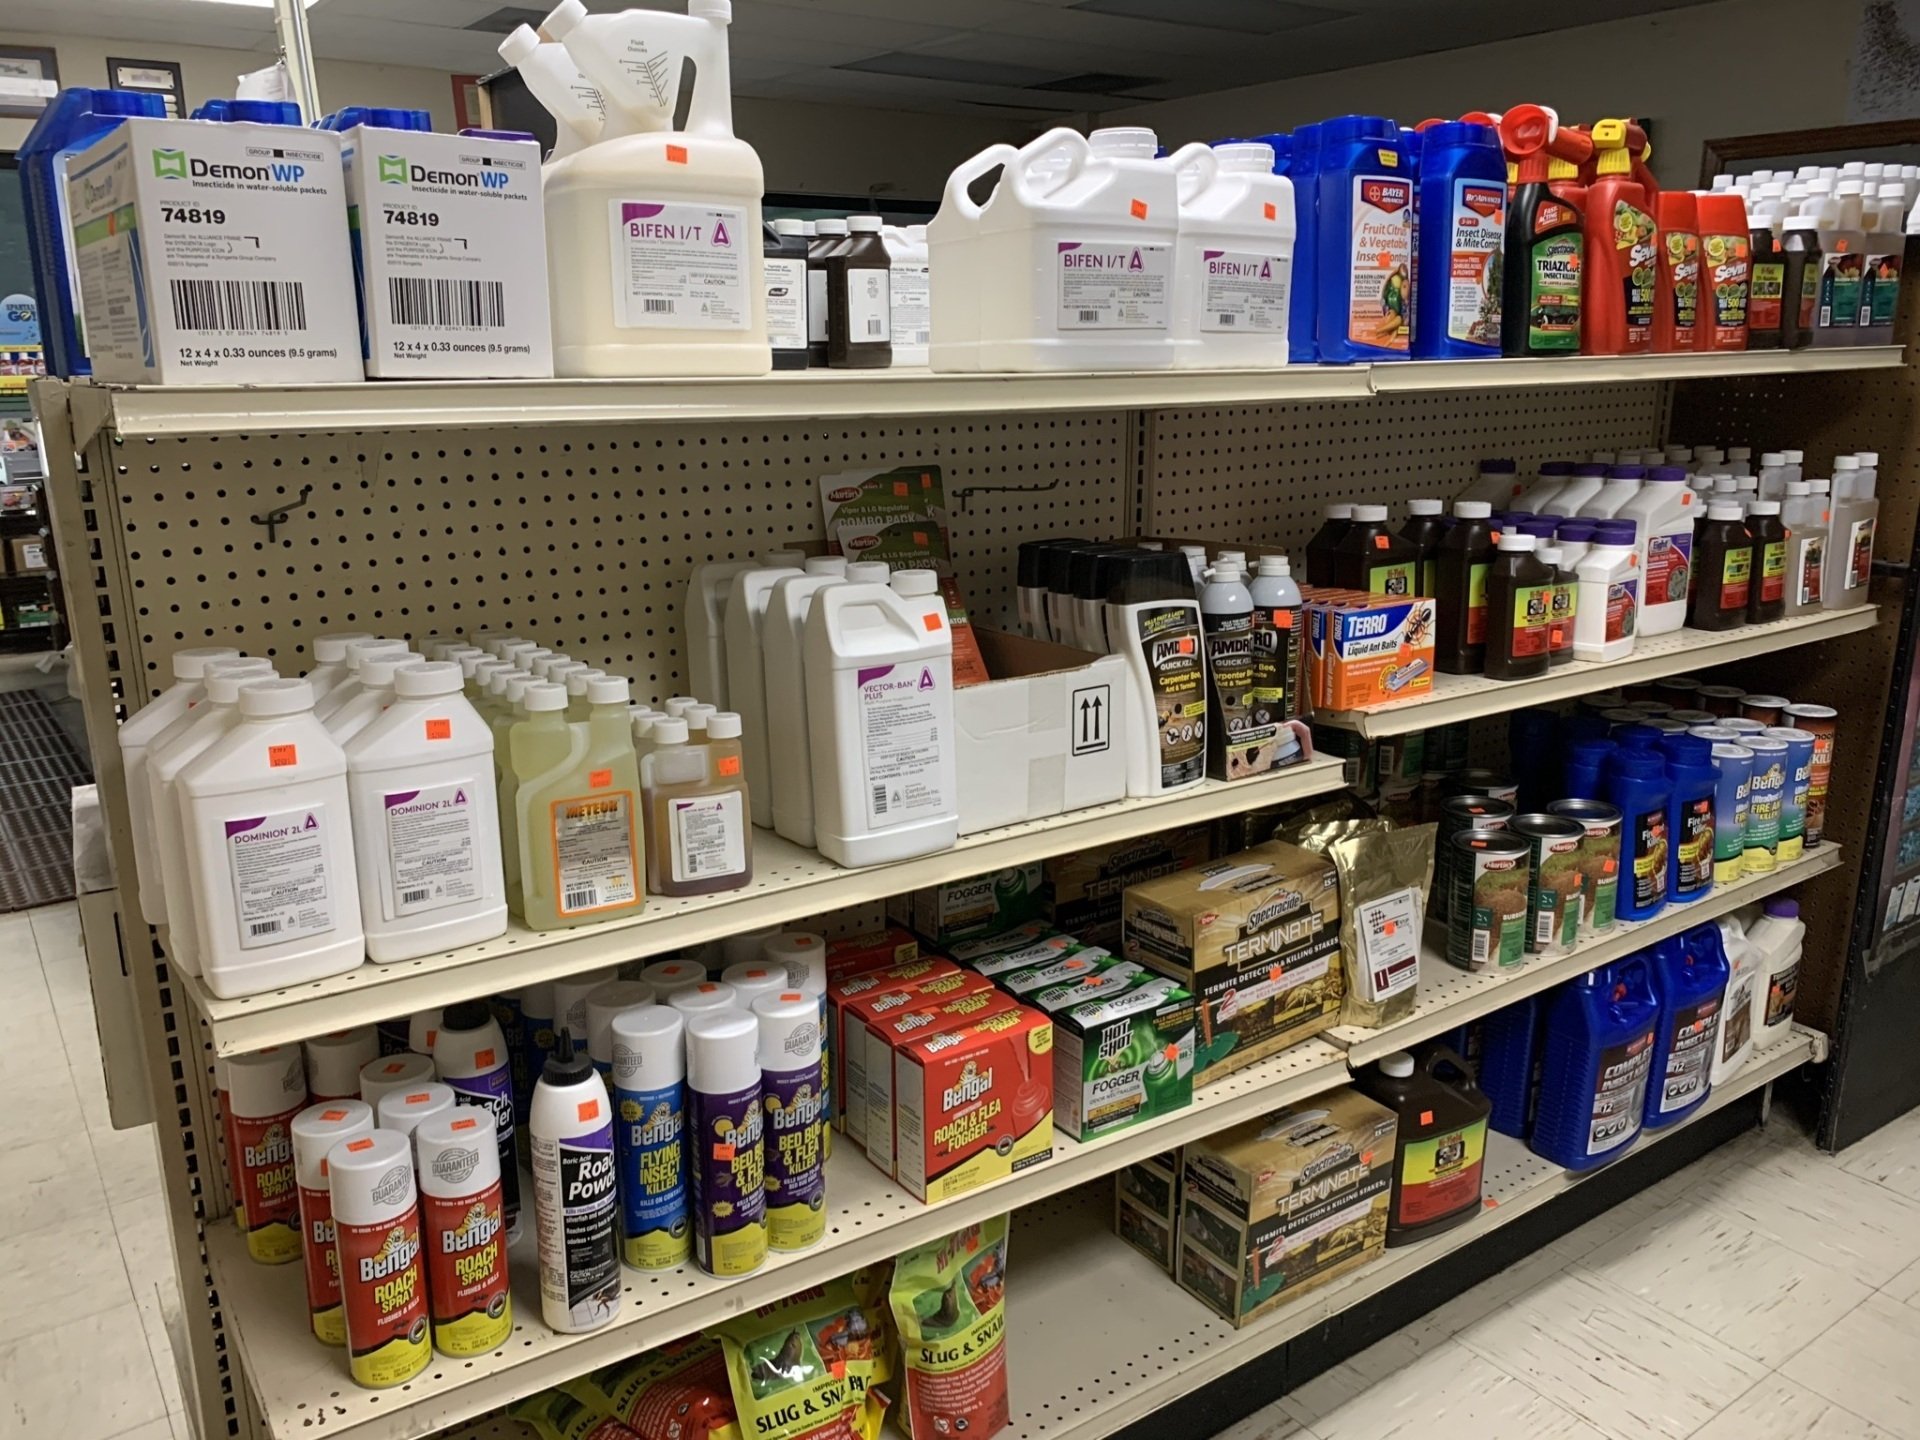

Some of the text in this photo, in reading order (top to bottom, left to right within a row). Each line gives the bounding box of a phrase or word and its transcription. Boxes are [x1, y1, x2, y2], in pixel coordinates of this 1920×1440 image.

[271, 163, 305, 182] WP
[480, 171, 509, 189] WP
[192, 180, 235, 190] Insecticide
[246, 184, 298, 193] water-soluble
[300, 187, 327, 195] packets
[412, 185, 449, 194] Insecticide
[458, 188, 502, 198] water-soluble
[503, 192, 528, 201] packets
[1382, 187, 1404, 198] BAYER
[161, 207, 226, 225] 74819
[383, 210, 440, 226] 74819
[630, 223, 702, 241] BIFEN I/T
[1362, 223, 1384, 235] Fruit
[1456, 228, 1479, 238] Insect
[1360, 236, 1408, 250] & Vegetable
[1456, 239, 1479, 248] & Mite
[1063, 254, 1126, 269] BIFEN I/T
[1209, 261, 1240, 276] BIFEN
[1714, 263, 1747, 282] Sevin
[179, 348, 192, 358] 12
[204, 348, 211, 358] 4
[223, 348, 245, 358] 0.33
[248, 350, 286, 358] ounces
[289, 348, 305, 359] (9.5
[306, 348, 337, 360] grams)
[394, 342, 405, 351] 12
[415, 342, 421, 351] 4
[431, 342, 451, 352] 0.33
[453, 344, 486, 353] ounces
[488, 344, 502, 353] (9.5
[504, 345, 530, 354] grams)
[839, 513, 916, 527] COMBO PACK
[1348, 613, 1387, 638] TERRO
[1348, 640, 1397, 656] Liquid Ant Baits
[1160, 661, 1180, 670] QUICK
[1215, 658, 1241, 667] QUICK
[864, 681, 913, 693] VECTOR-BAN
[864, 692, 883, 701] PLUS
[391, 800, 452, 816] DOMINION 2L
[1752, 803, 1770, 814] FIRE
[234, 826, 302, 844] DOMINION 2L
[271, 886, 299, 897] CAUTION
[947, 883, 992, 902] FOGGER
[1248, 896, 1301, 931] Spectracide
[1225, 912, 1322, 963] TERMINATE
[1204, 976, 1237, 996] TERMITE
[1286, 947, 1313, 964] KILLING
[1314, 936, 1339, 952] STAKES
[872, 992, 912, 1013] Bengal
[1108, 992, 1150, 1009] FOGGER
[894, 1012, 935, 1033] Bengal
[1102, 1018, 1130, 1043] HOT
[924, 1031, 966, 1053] Bengal
[1099, 1030, 1134, 1059] SHOT
[942, 1067, 993, 1112] Bengal
[1092, 1070, 1139, 1095] FOGGER
[934, 1098, 1002, 1146] ROACH & FLEA
[779, 1132, 802, 1152] BED
[948, 1121, 988, 1153] FOGGER
[579, 1154, 591, 1163] Acid
[640, 1140, 681, 1168] FLYING
[784, 1137, 819, 1165] & FLEA
[432, 1151, 480, 1175] GUARANTEED
[640, 1155, 682, 1185] INSECT
[732, 1150, 754, 1174] BED
[789, 1154, 816, 1175] KILLER
[646, 1175, 678, 1196] KILLER
[736, 1171, 746, 1188] &
[1278, 1163, 1370, 1216] TERMINATE
[1256, 1227, 1287, 1244] TERMITE
[1288, 1207, 1326, 1229] DETECTION
[1332, 1193, 1358, 1209] KILLING
[443, 1209, 501, 1253] Bengal
[361, 1226, 420, 1282] Bengal
[455, 1241, 498, 1276] ROACH
[462, 1260, 494, 1286] SPRAY
[375, 1264, 418, 1304] ROACH
[457, 1272, 500, 1298] FLUSHES KILLS
[377, 1296, 420, 1326] FLUSHES KILLS
[382, 1288, 415, 1313] SPRAY
[920, 1347, 959, 1364] SLUG
[962, 1342, 974, 1357] &
[616, 1375, 647, 1414] SLUG
[756, 1398, 819, 1433] SLUG &
